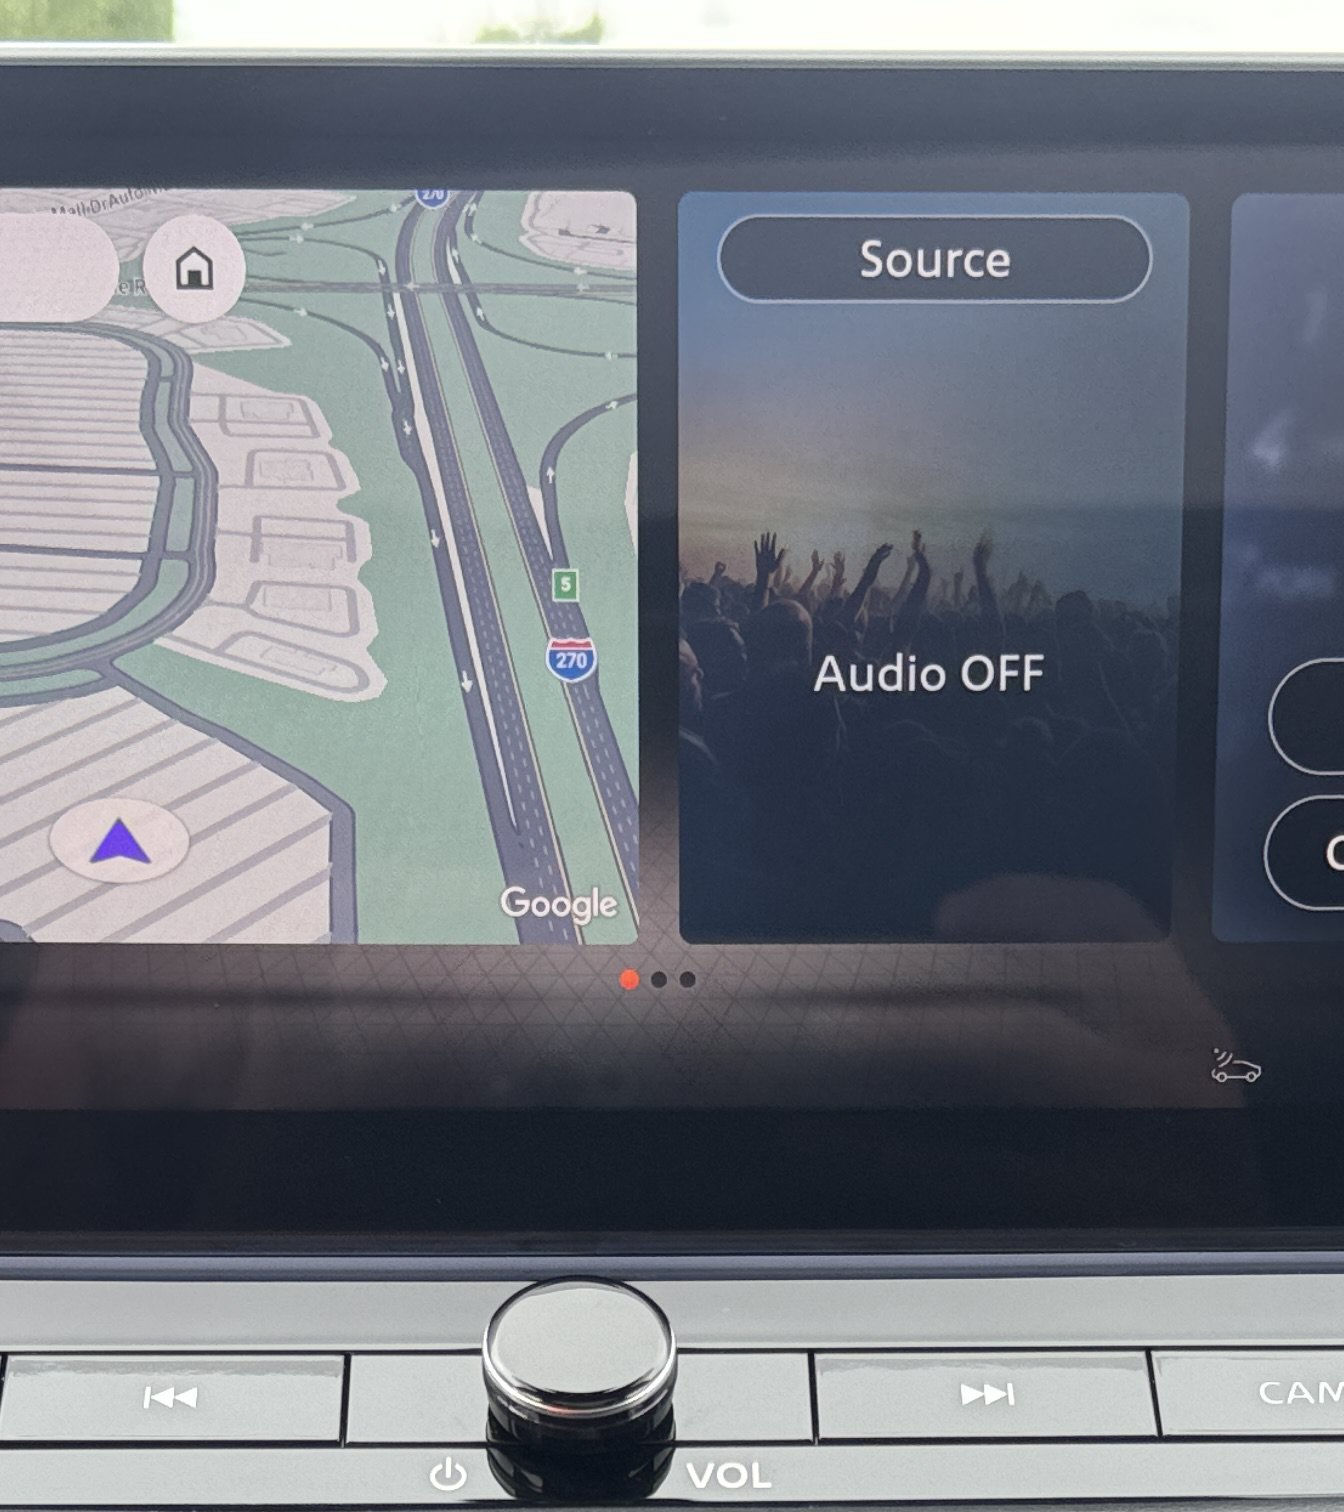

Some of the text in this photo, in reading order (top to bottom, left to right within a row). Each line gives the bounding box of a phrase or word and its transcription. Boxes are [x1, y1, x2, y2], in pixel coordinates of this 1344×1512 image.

[861, 239, 1011, 278] Source
[560, 576, 572, 592] 5
[556, 652, 588, 669] 270
[813, 652, 1045, 692] Audio OFF
[500, 886, 618, 926] Google
[686, 1461, 772, 1489] VOL
